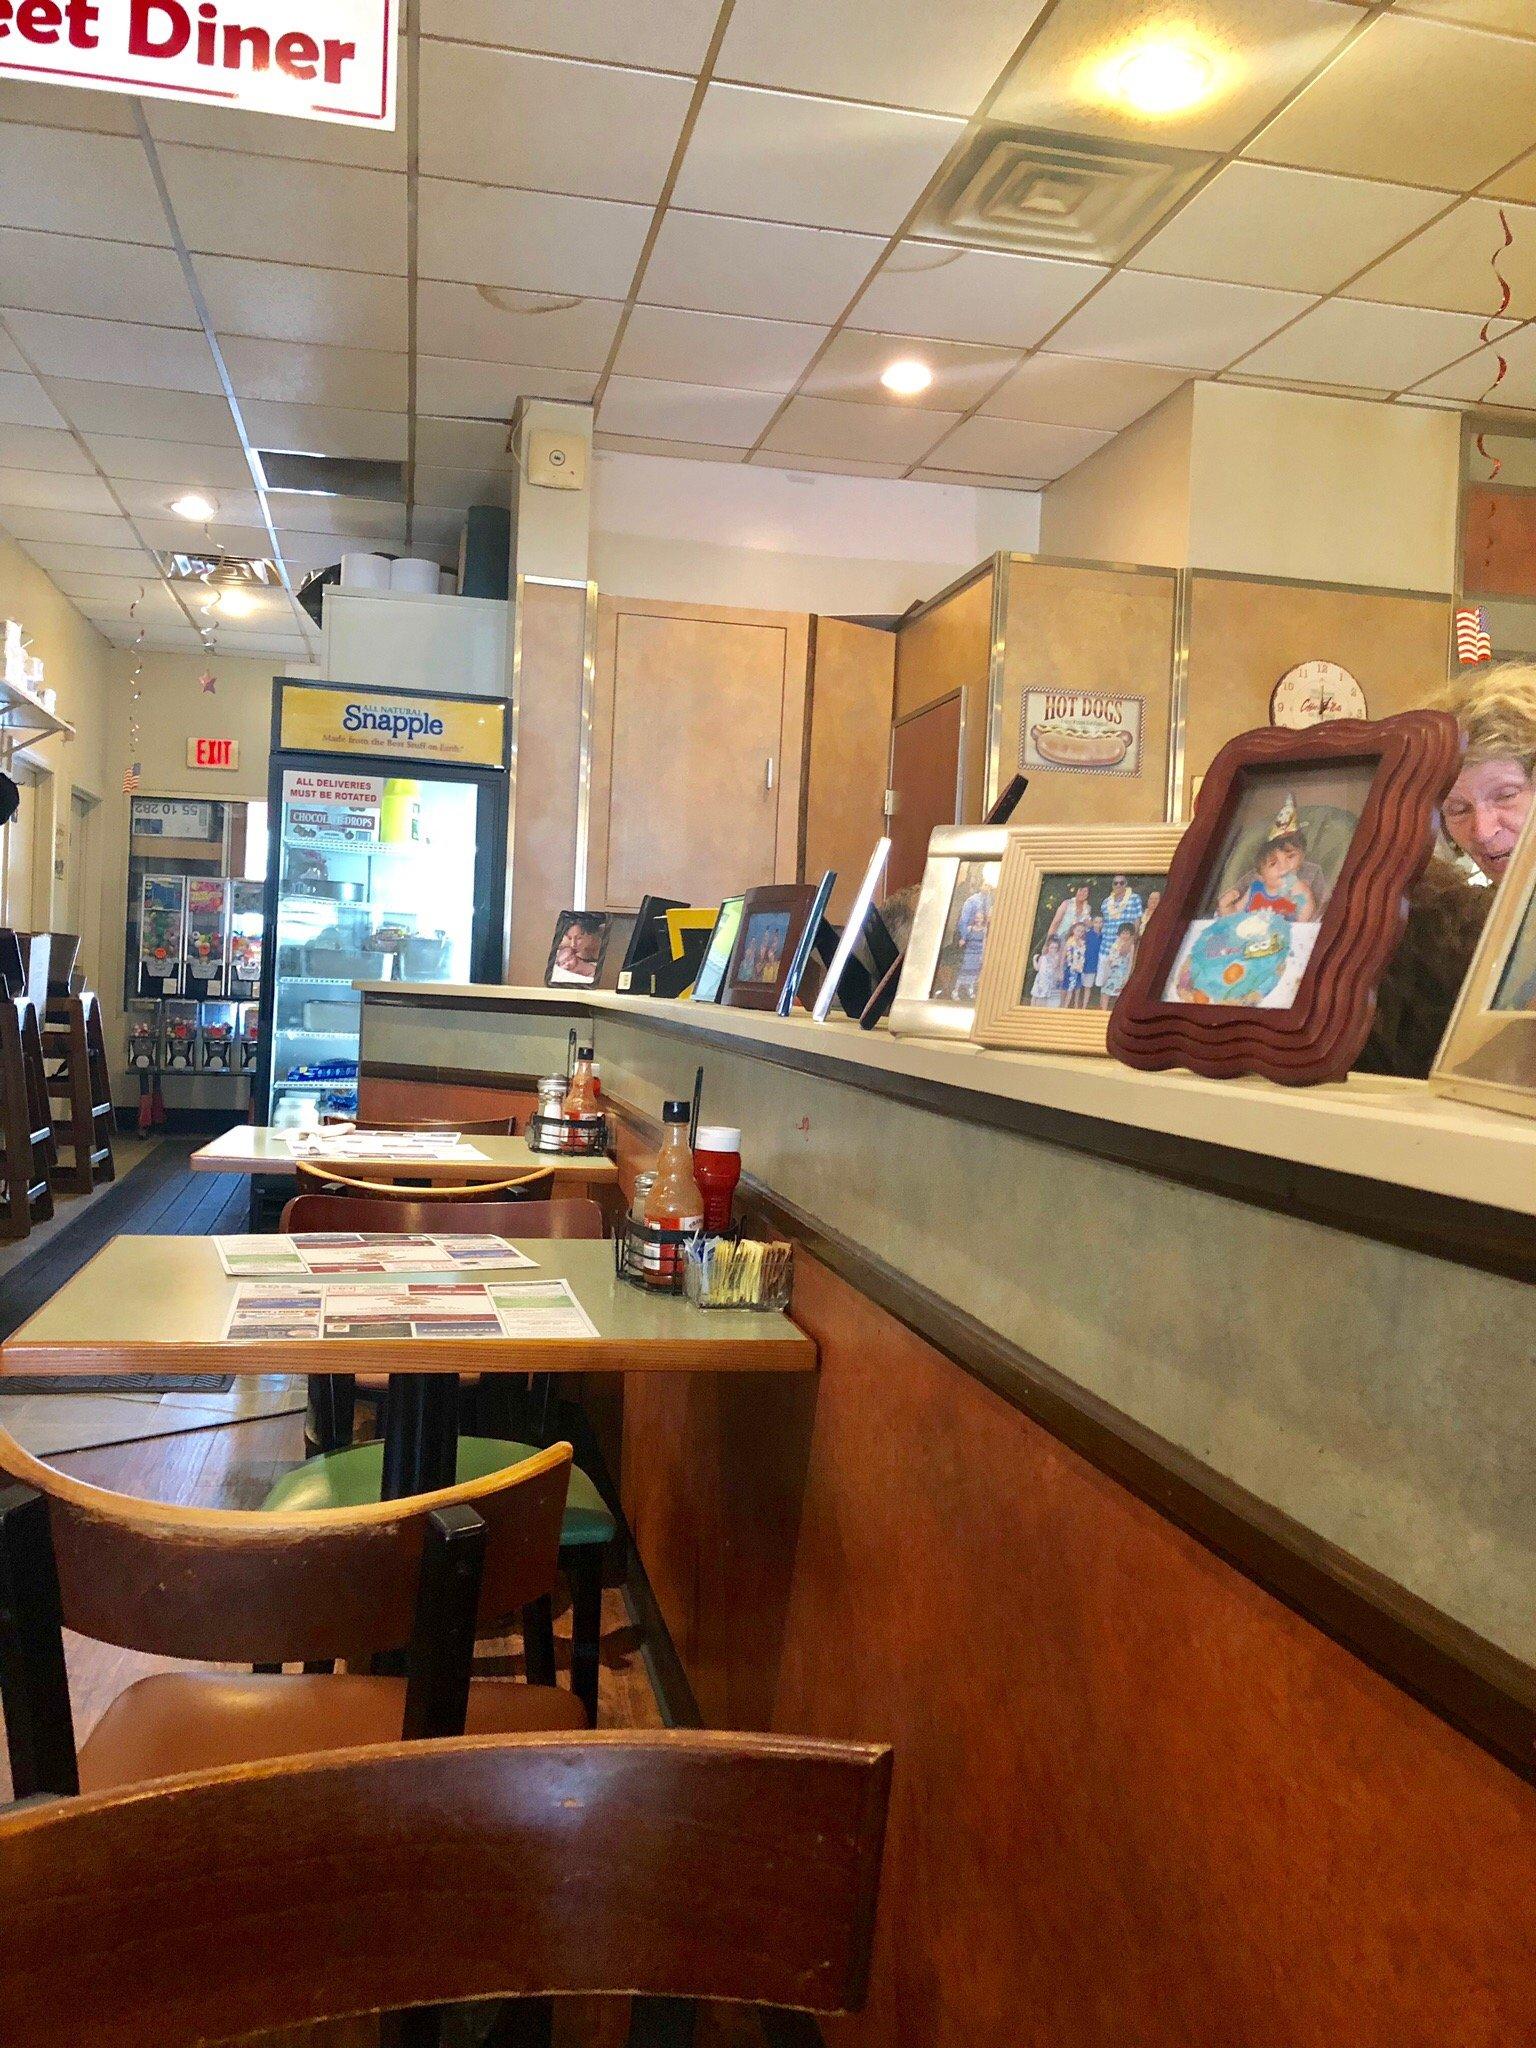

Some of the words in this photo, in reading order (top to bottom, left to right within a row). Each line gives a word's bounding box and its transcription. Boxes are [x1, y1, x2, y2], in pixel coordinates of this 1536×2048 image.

[0, 0, 99, 49] et
[128, 0, 356, 84] Diner
[1317, 664, 1328, 674] 12
[381, 706, 422, 716] NATURAL
[1044, 696, 1078, 720] HOT
[1082, 698, 1122, 724] DOGS
[343, 704, 444, 740] Snapple
[371, 738, 384, 746] the
[197, 739, 232, 765] EXIT
[296, 777, 314, 786] ALL
[316, 780, 372, 790] DELIVERIES
[290, 789, 316, 798] MUST
[319, 791, 332, 799] BE
[335, 792, 377, 802] ROTATED
[346, 815, 373, 828] DROPS
